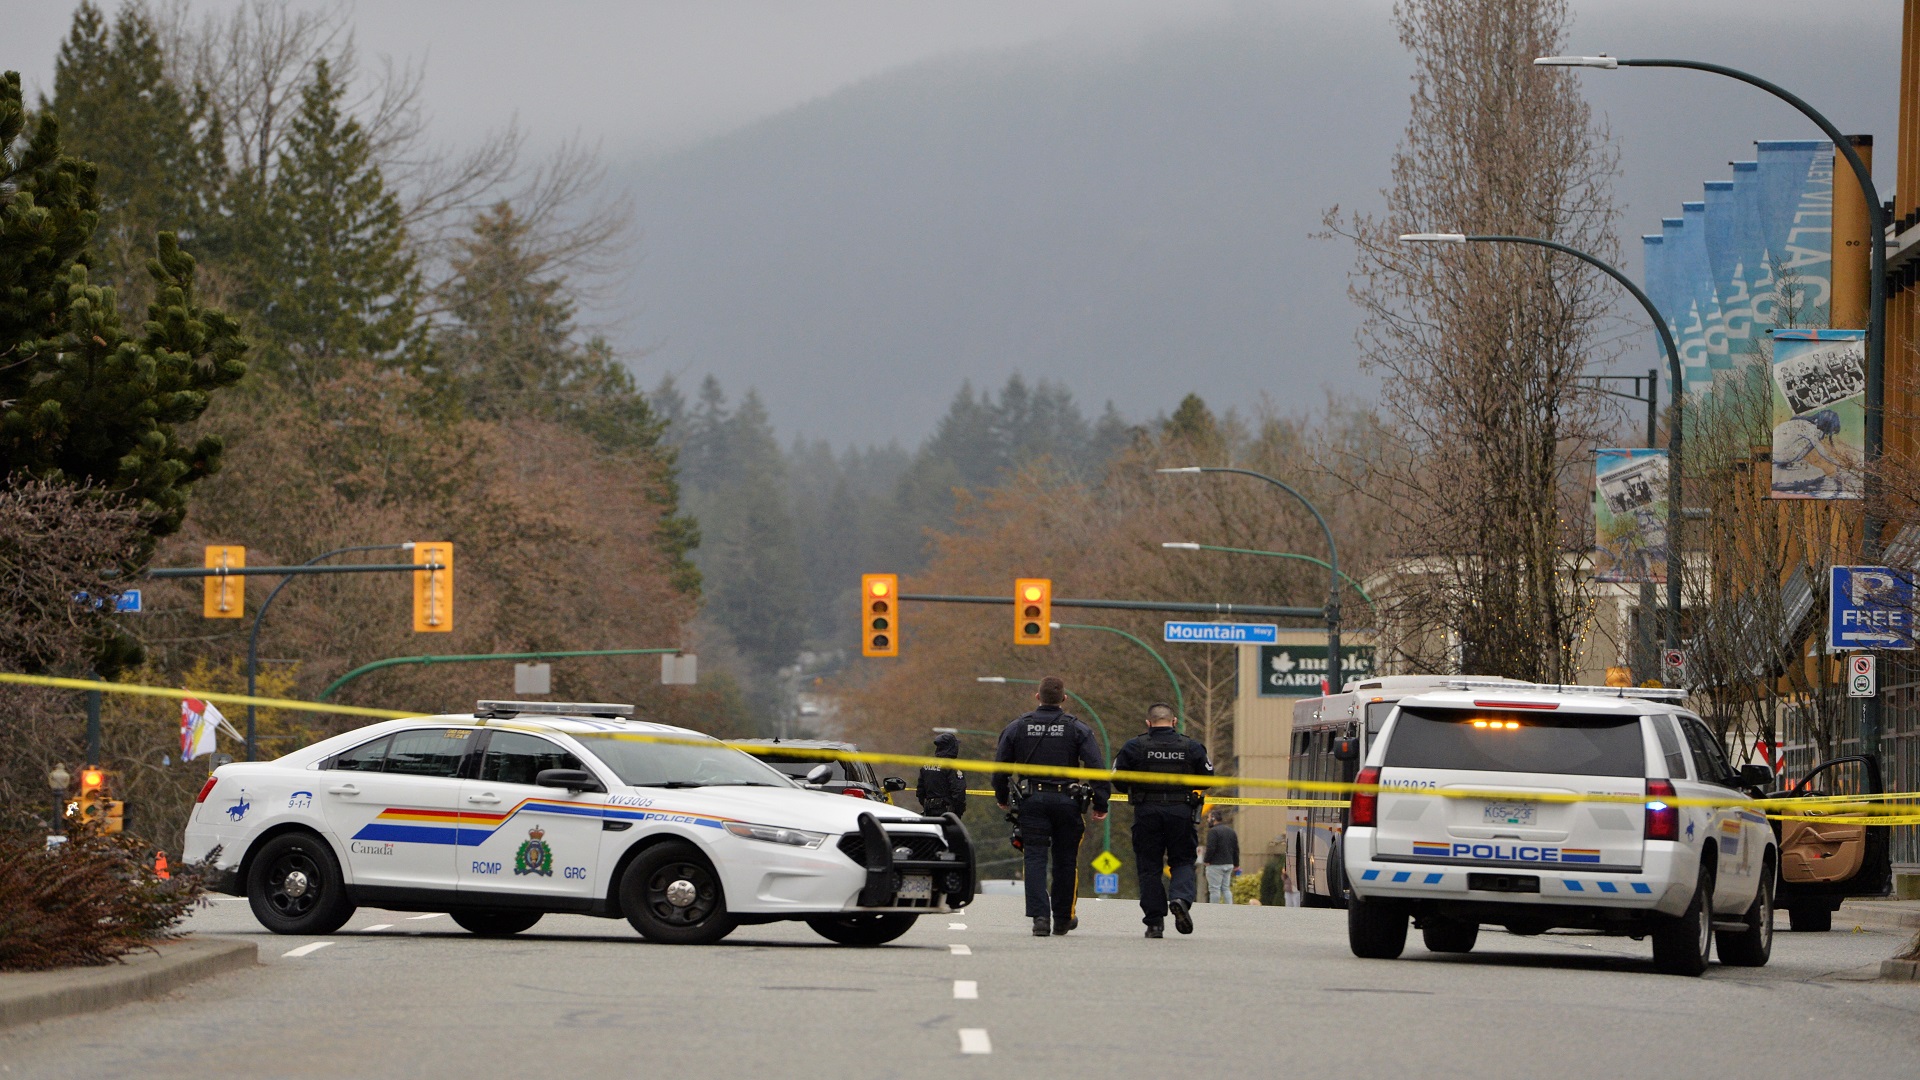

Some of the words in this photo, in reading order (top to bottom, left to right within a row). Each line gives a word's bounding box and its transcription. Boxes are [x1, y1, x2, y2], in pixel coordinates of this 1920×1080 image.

[1851, 572, 1894, 606] P
[1842, 609, 1902, 626] FREE
[1168, 625, 1246, 640] Mountain
[1253, 627, 1273, 637] Hwy
[1270, 672, 1344, 686] GARDE
[1027, 724, 1064, 732] POLICE
[1147, 751, 1185, 760] POLICE
[1382, 779, 1437, 791] NV3025
[288, 799, 311, 808] 9-1-1
[607, 795, 655, 808] NV3005
[644, 813, 695, 824] POLICE
[350, 841, 394, 856] Canada
[1453, 843, 1559, 862] POLICE
[472, 861, 502, 875] RCMP
[564, 866, 587, 880] GRC
